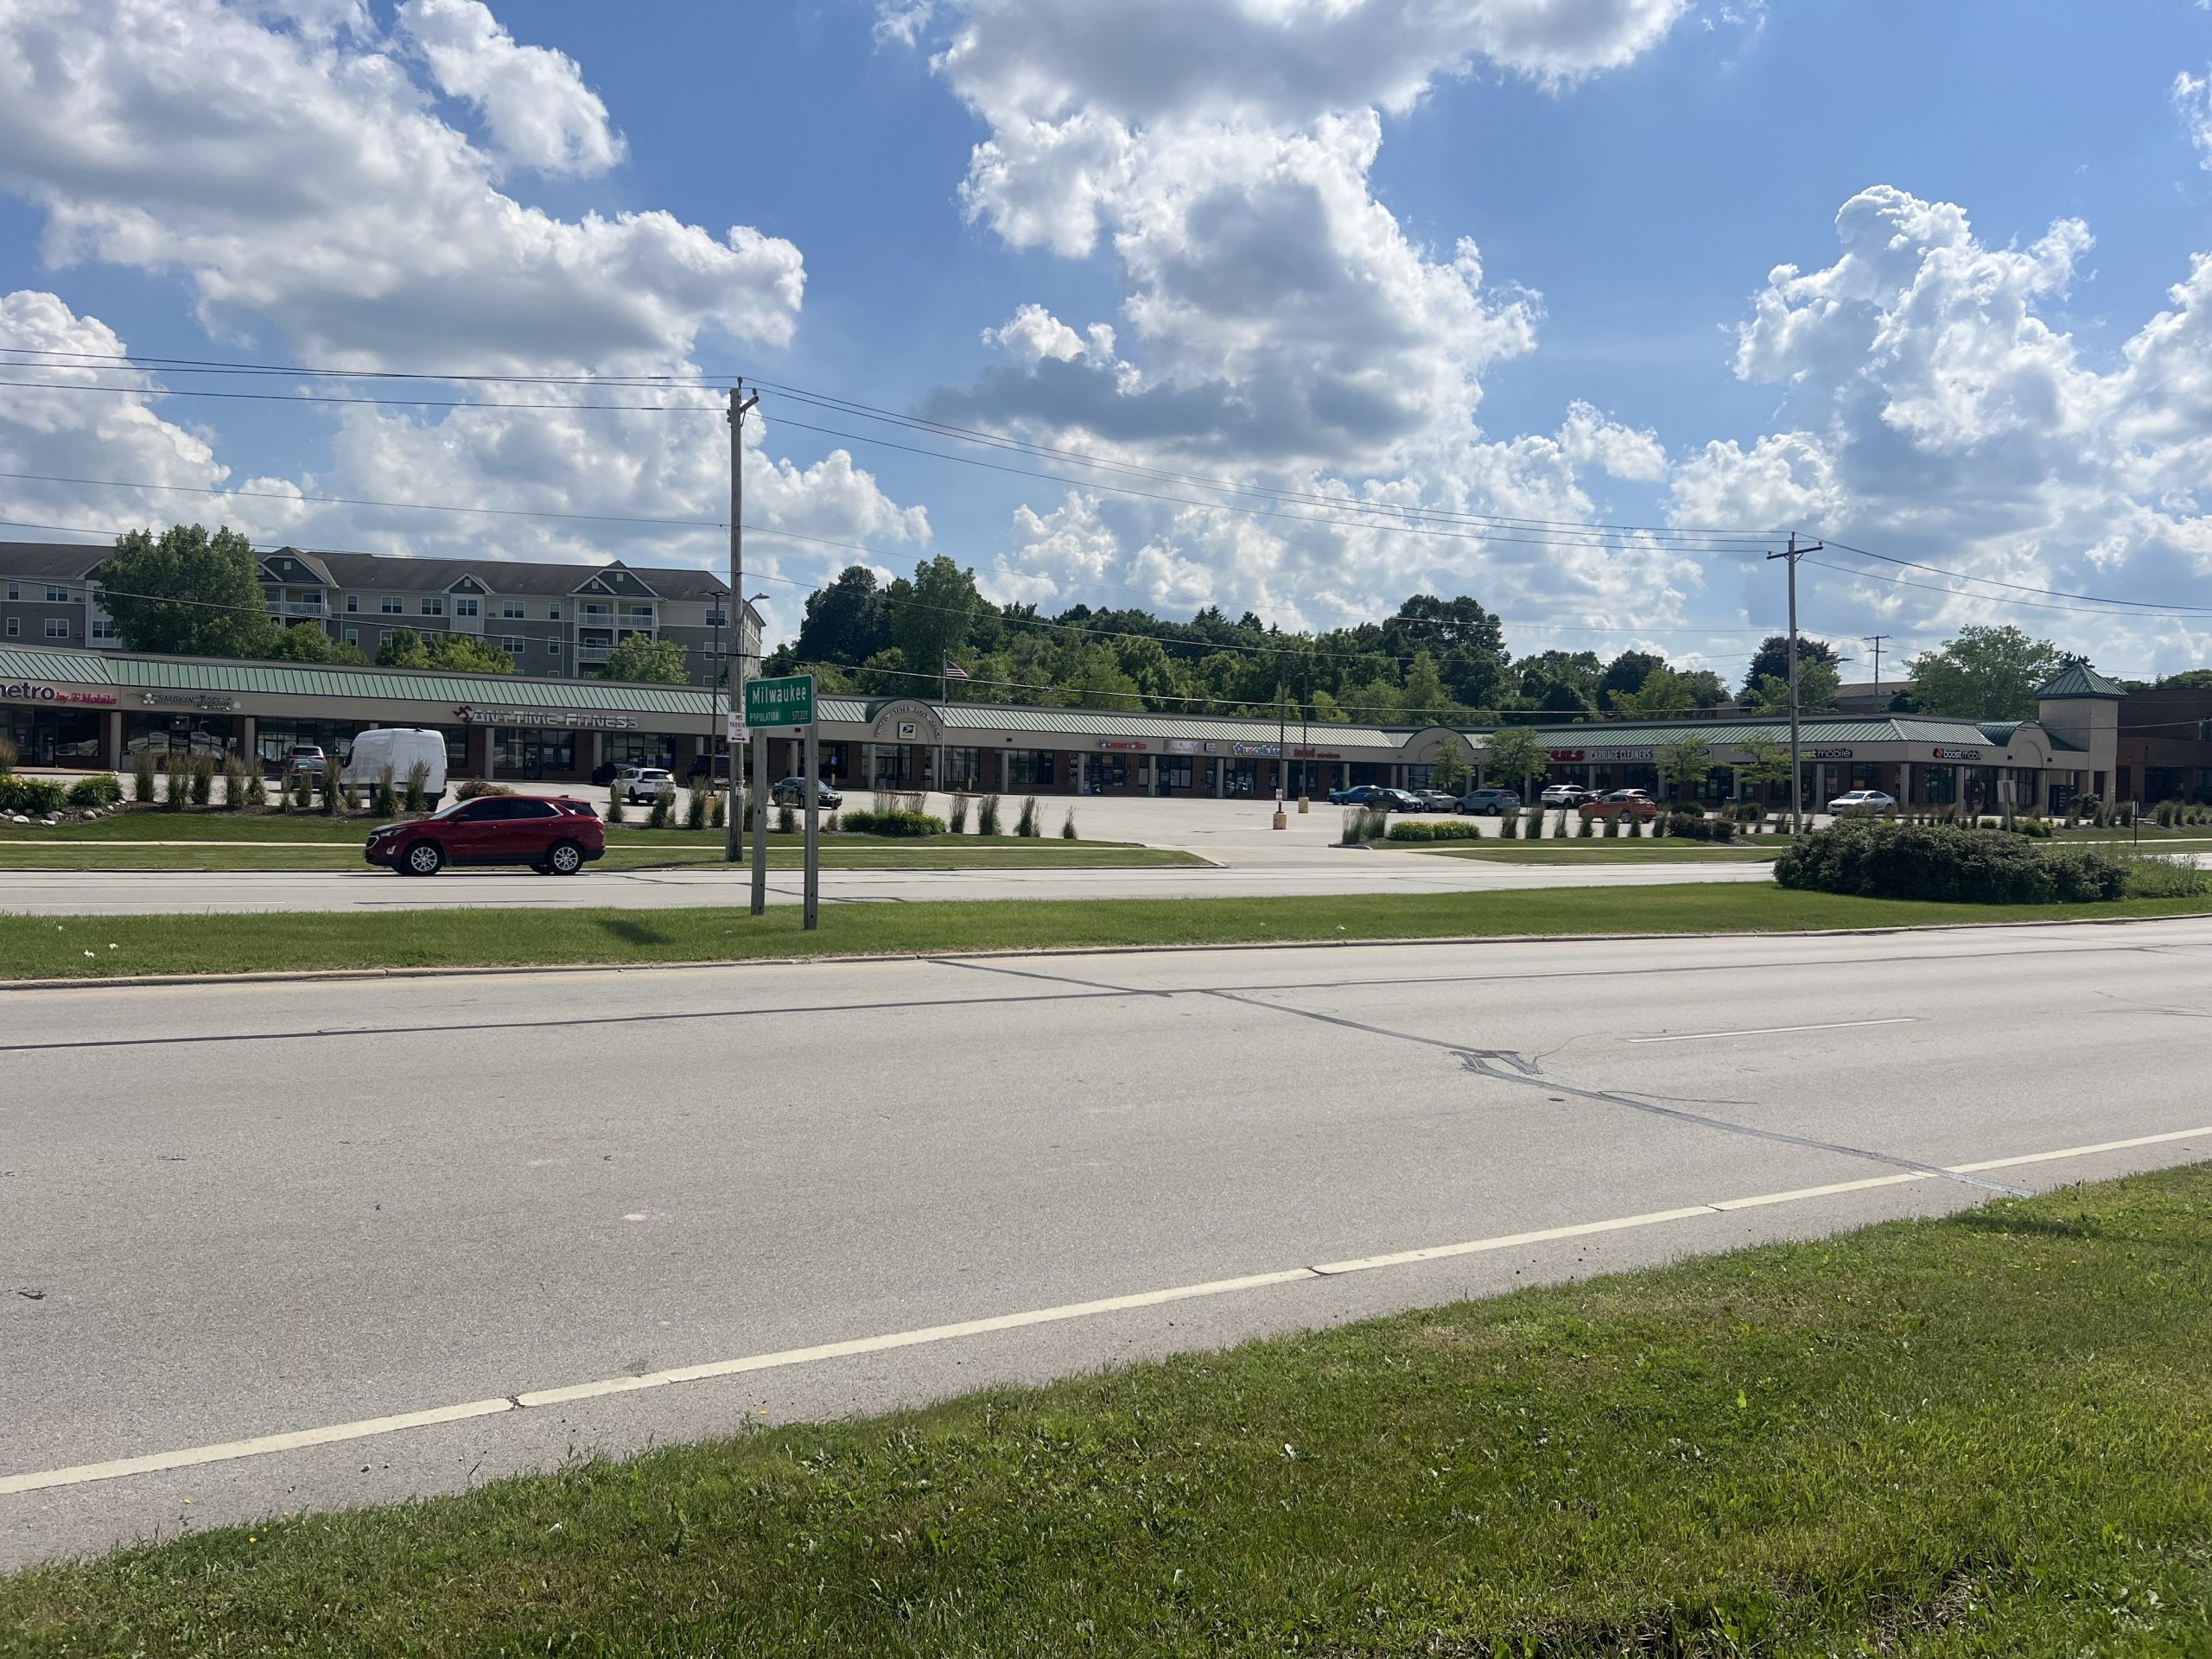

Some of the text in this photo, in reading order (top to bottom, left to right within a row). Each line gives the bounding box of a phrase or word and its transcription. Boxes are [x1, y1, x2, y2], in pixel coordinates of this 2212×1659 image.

[56, 692, 69, 703] by
[752, 684, 807, 704] Milwaukee
[473, 709, 639, 728] ANYTIME FITNESS
[749, 712, 779, 721] POPULATION
[876, 715, 890, 737] UNITED
[890, 705, 912, 715] STATES
[930, 719, 942, 741] OFFICE
[1590, 749, 1651, 761] CARRIAGE CLEANERS
